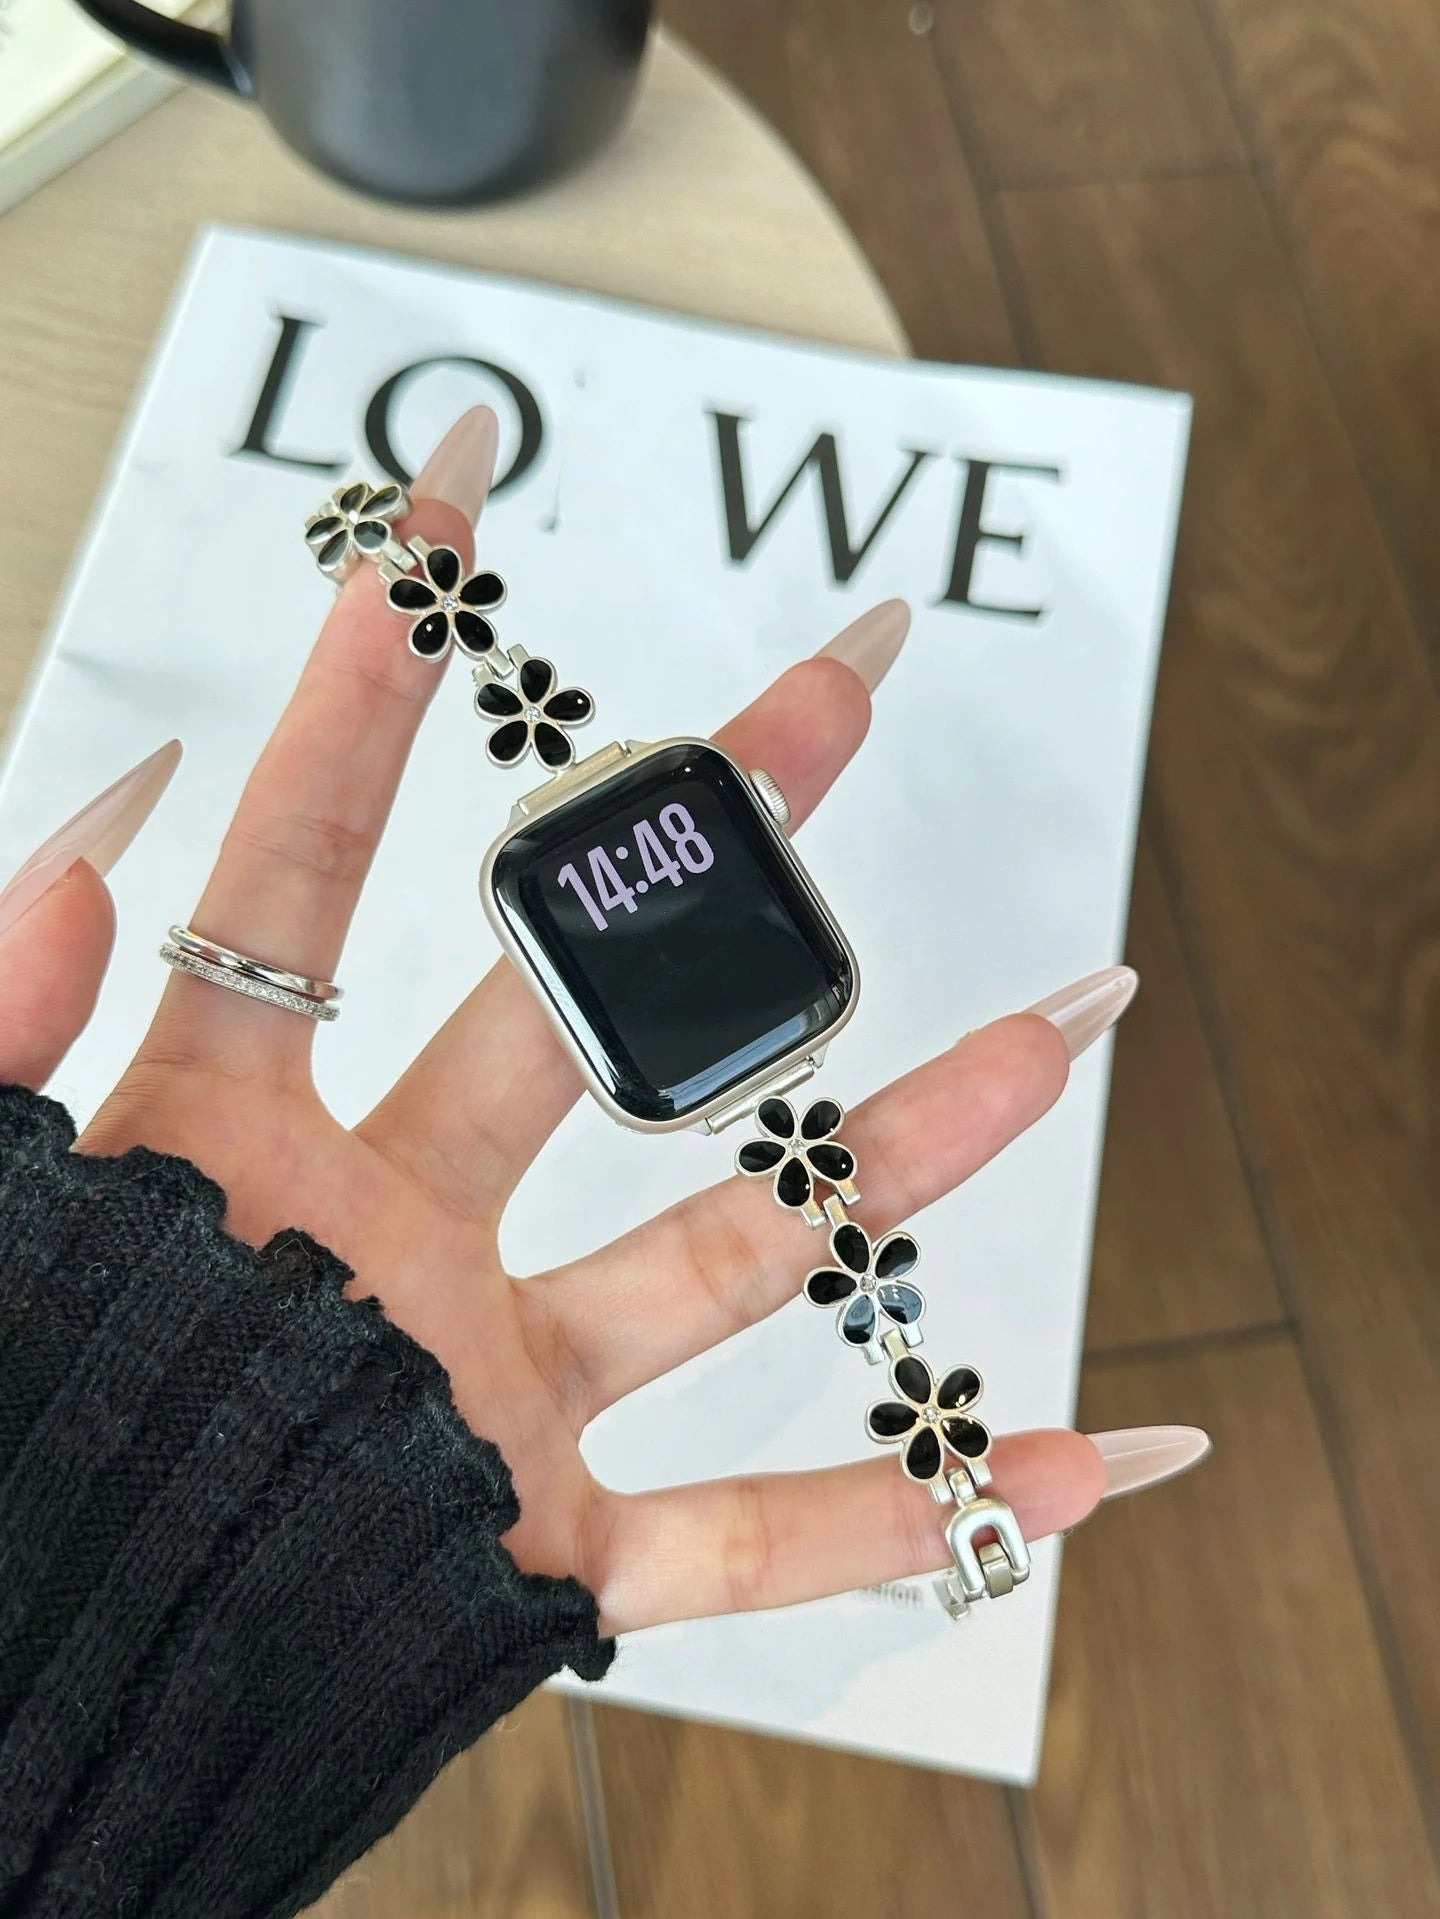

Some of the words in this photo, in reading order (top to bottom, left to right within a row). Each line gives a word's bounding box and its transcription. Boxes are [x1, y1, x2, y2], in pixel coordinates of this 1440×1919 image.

[230, 309, 546, 498] LO
[701, 407, 1065, 620] WE
[556, 802, 715, 932] 14:48
